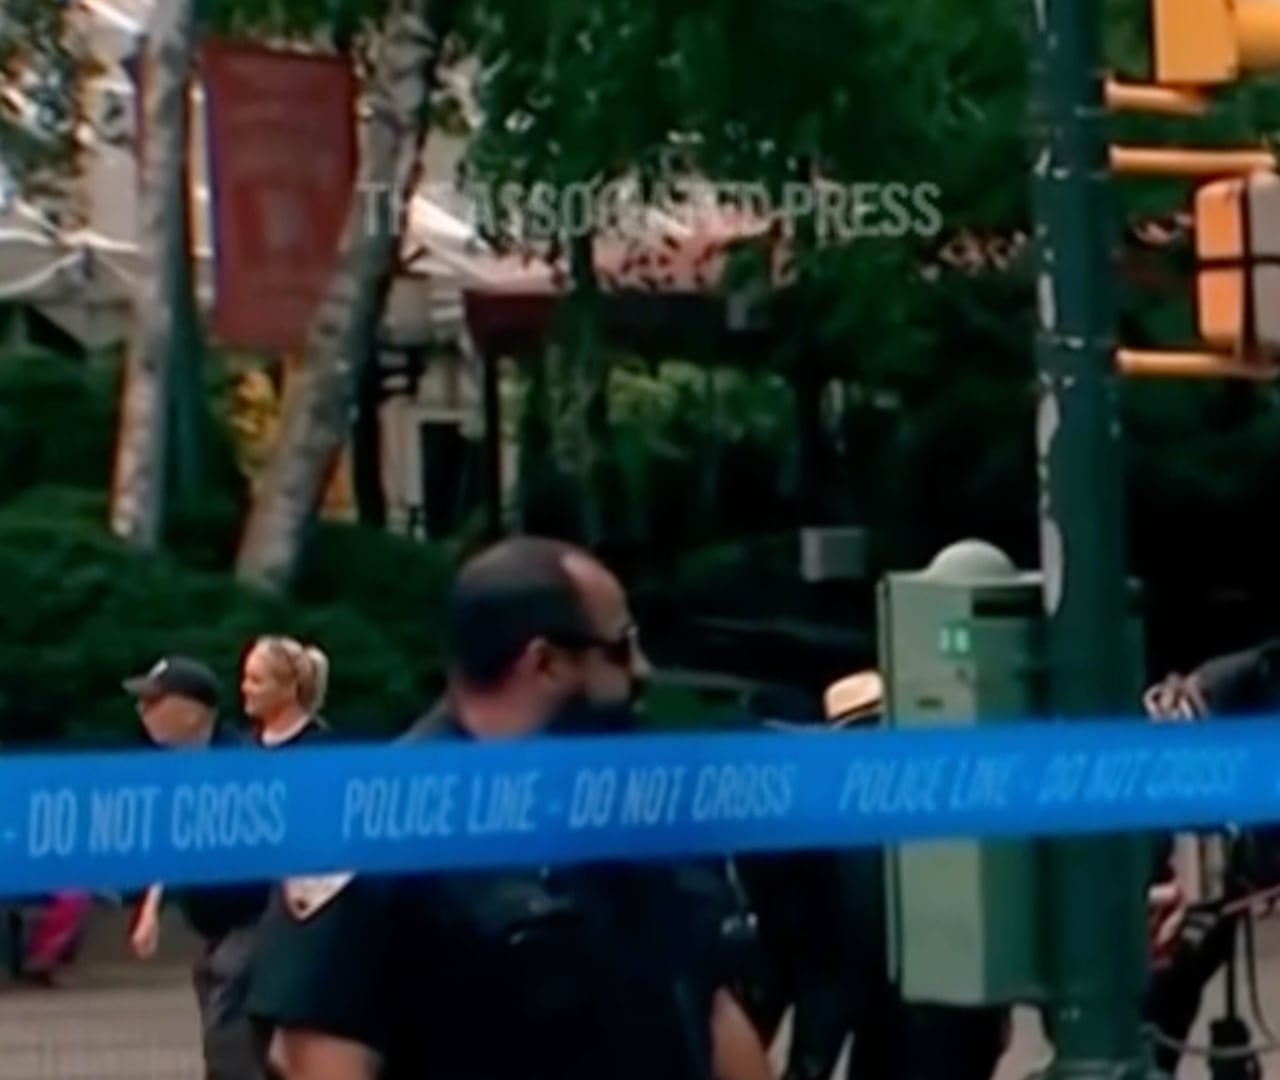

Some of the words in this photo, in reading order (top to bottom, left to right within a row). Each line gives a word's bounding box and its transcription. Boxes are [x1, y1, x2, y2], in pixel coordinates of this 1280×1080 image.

[27, 789, 78, 858] DO
[88, 786, 163, 856] NOT
[171, 780, 287, 850] CROSS
[342, 774, 460, 842] POLICE
[467, 768, 545, 835] LINE
[569, 768, 617, 829] DO
[620, 764, 688, 827] NOT
[691, 760, 798, 822] CROSS
